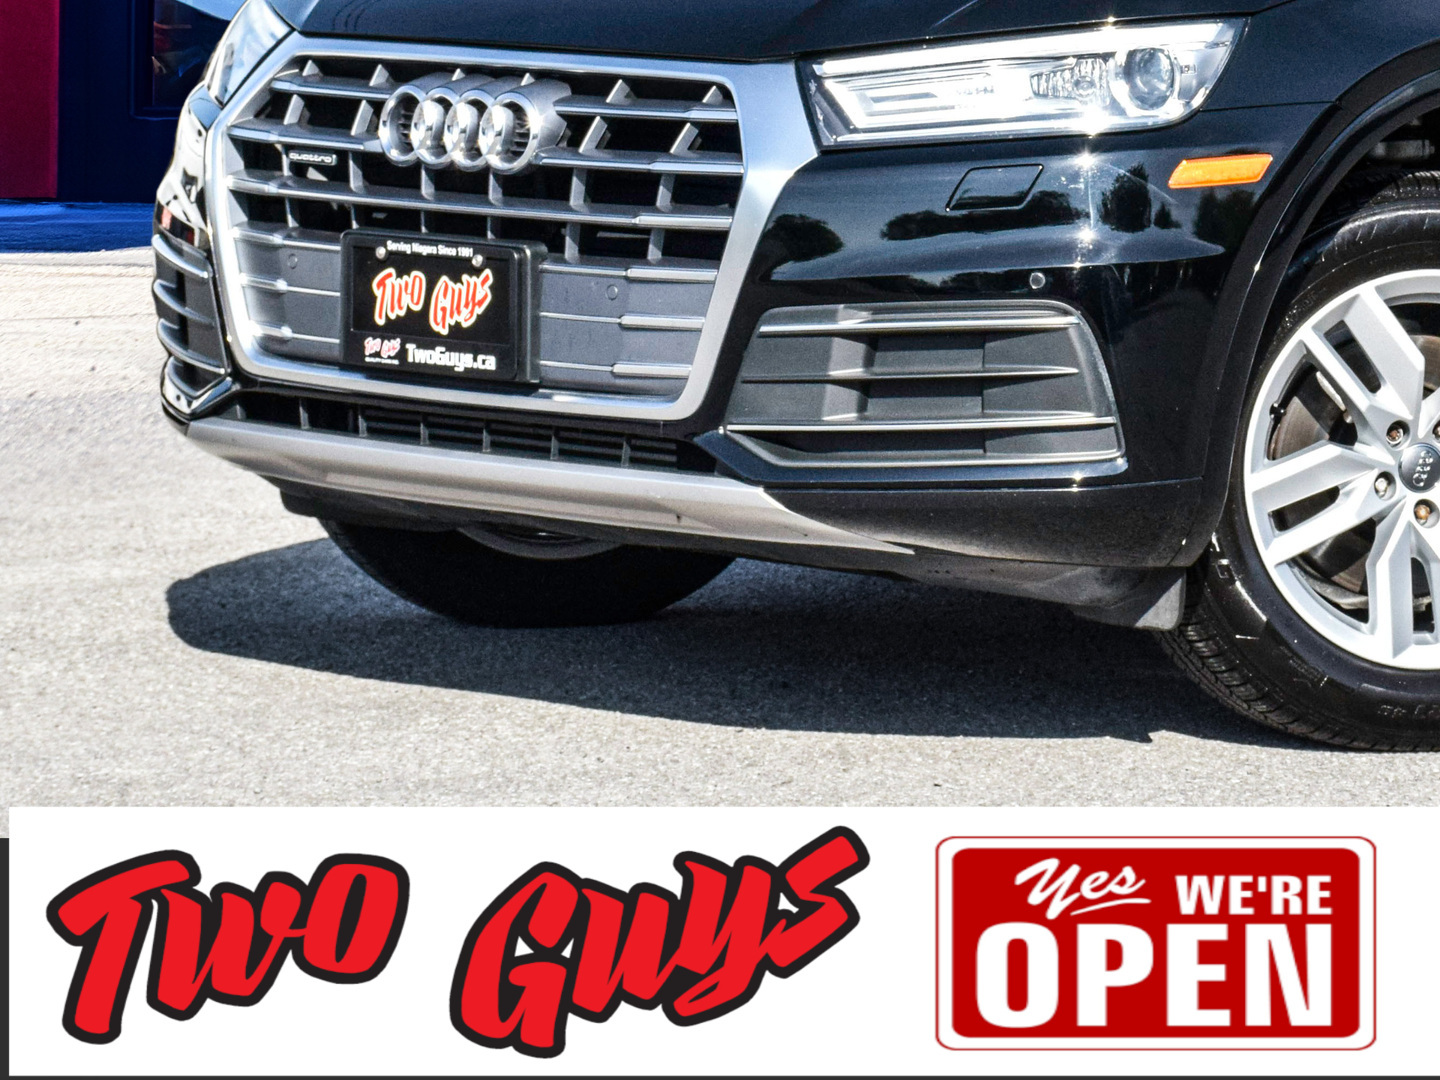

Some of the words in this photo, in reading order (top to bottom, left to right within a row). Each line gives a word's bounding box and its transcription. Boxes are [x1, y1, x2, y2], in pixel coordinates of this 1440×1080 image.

[386, 240, 412, 254] Serving
[411, 242, 438, 256] Niagara
[437, 244, 457, 257] Since
[405, 343, 497, 372] TwoGuys.ca
